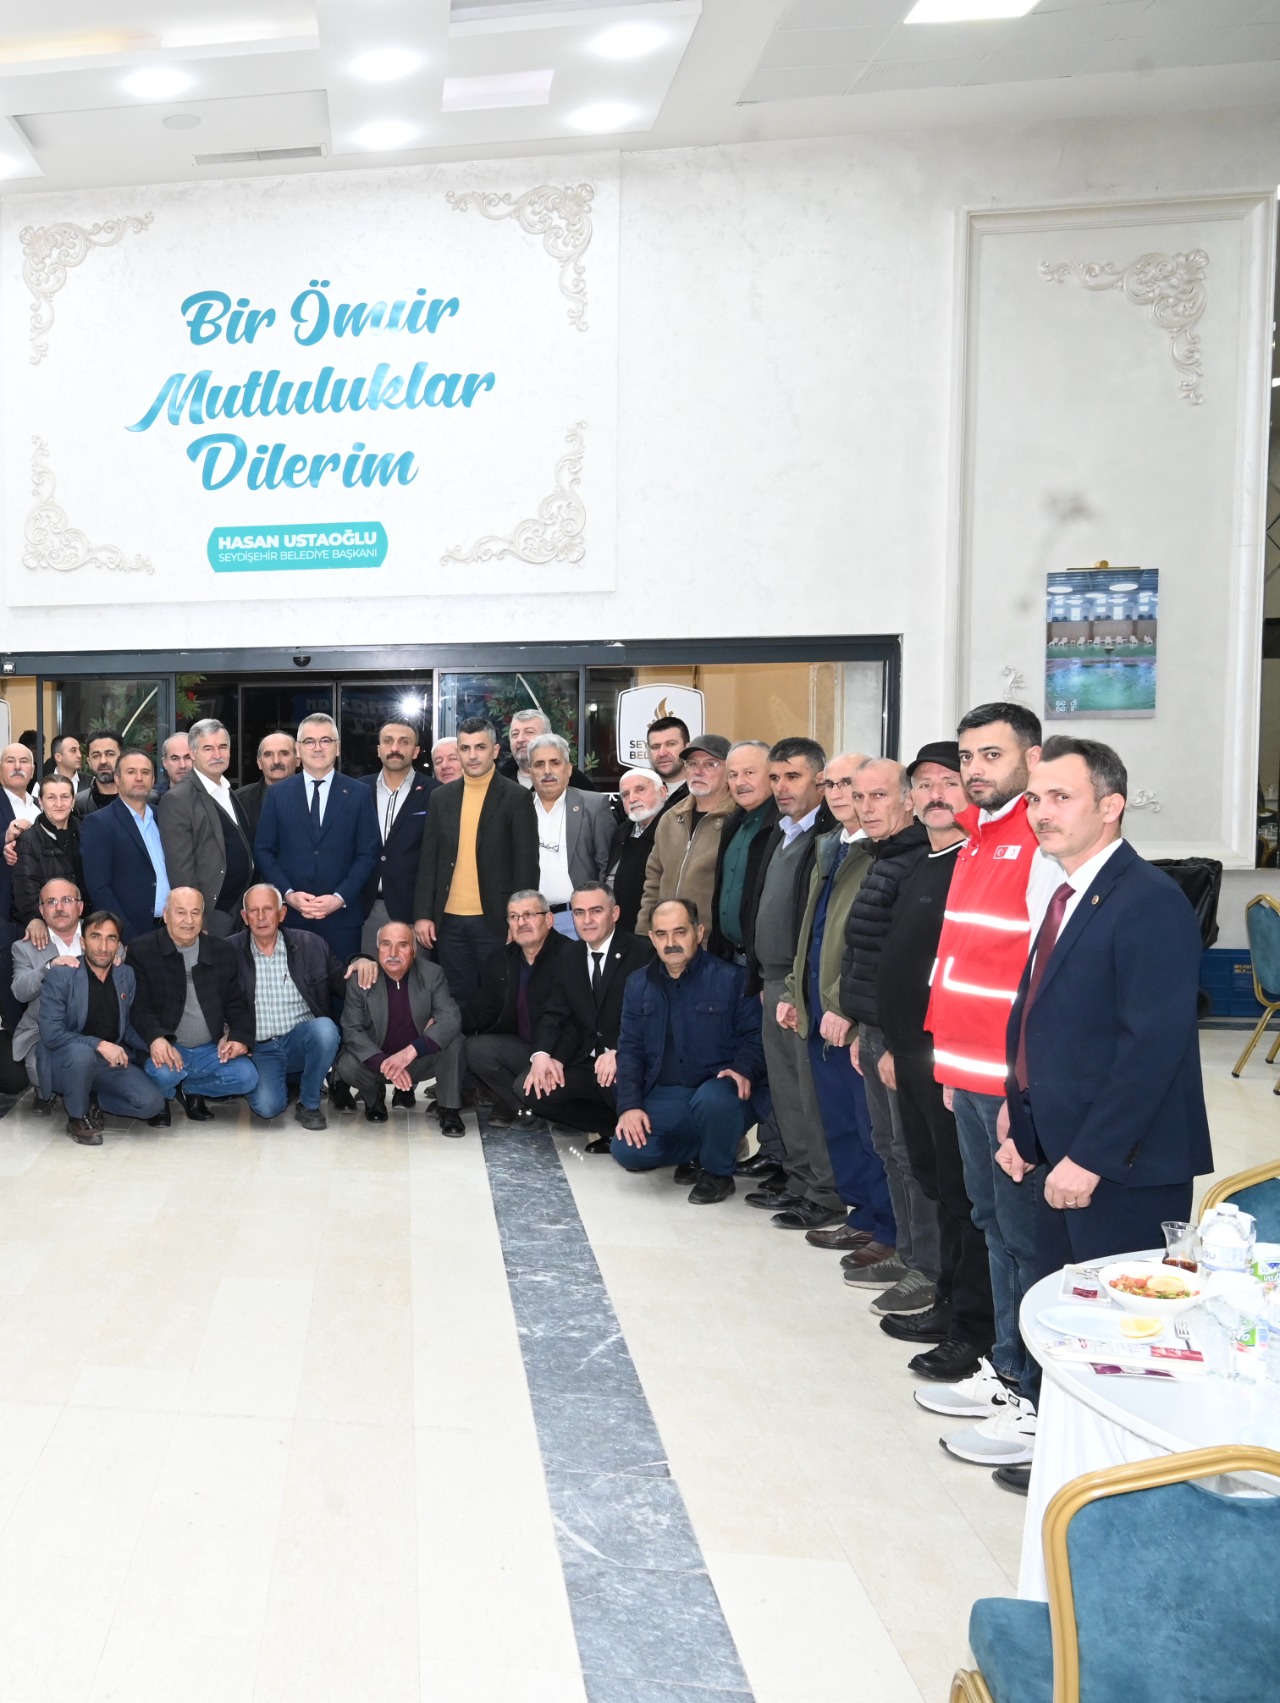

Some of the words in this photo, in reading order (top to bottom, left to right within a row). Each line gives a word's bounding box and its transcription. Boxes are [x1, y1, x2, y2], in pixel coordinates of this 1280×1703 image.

[180, 290, 276, 346] Bir
[124, 361, 495, 432] Mutluluklar
[186, 432, 419, 491] Dilerim
[218, 534, 279, 550] HASAN
[283, 529, 377, 548] USTAOĞLU
[218, 551, 278, 563] SEYDİŞEHİR
[280, 549, 329, 561] BELEDİYE
[332, 548, 377, 561] BAŞKANI
